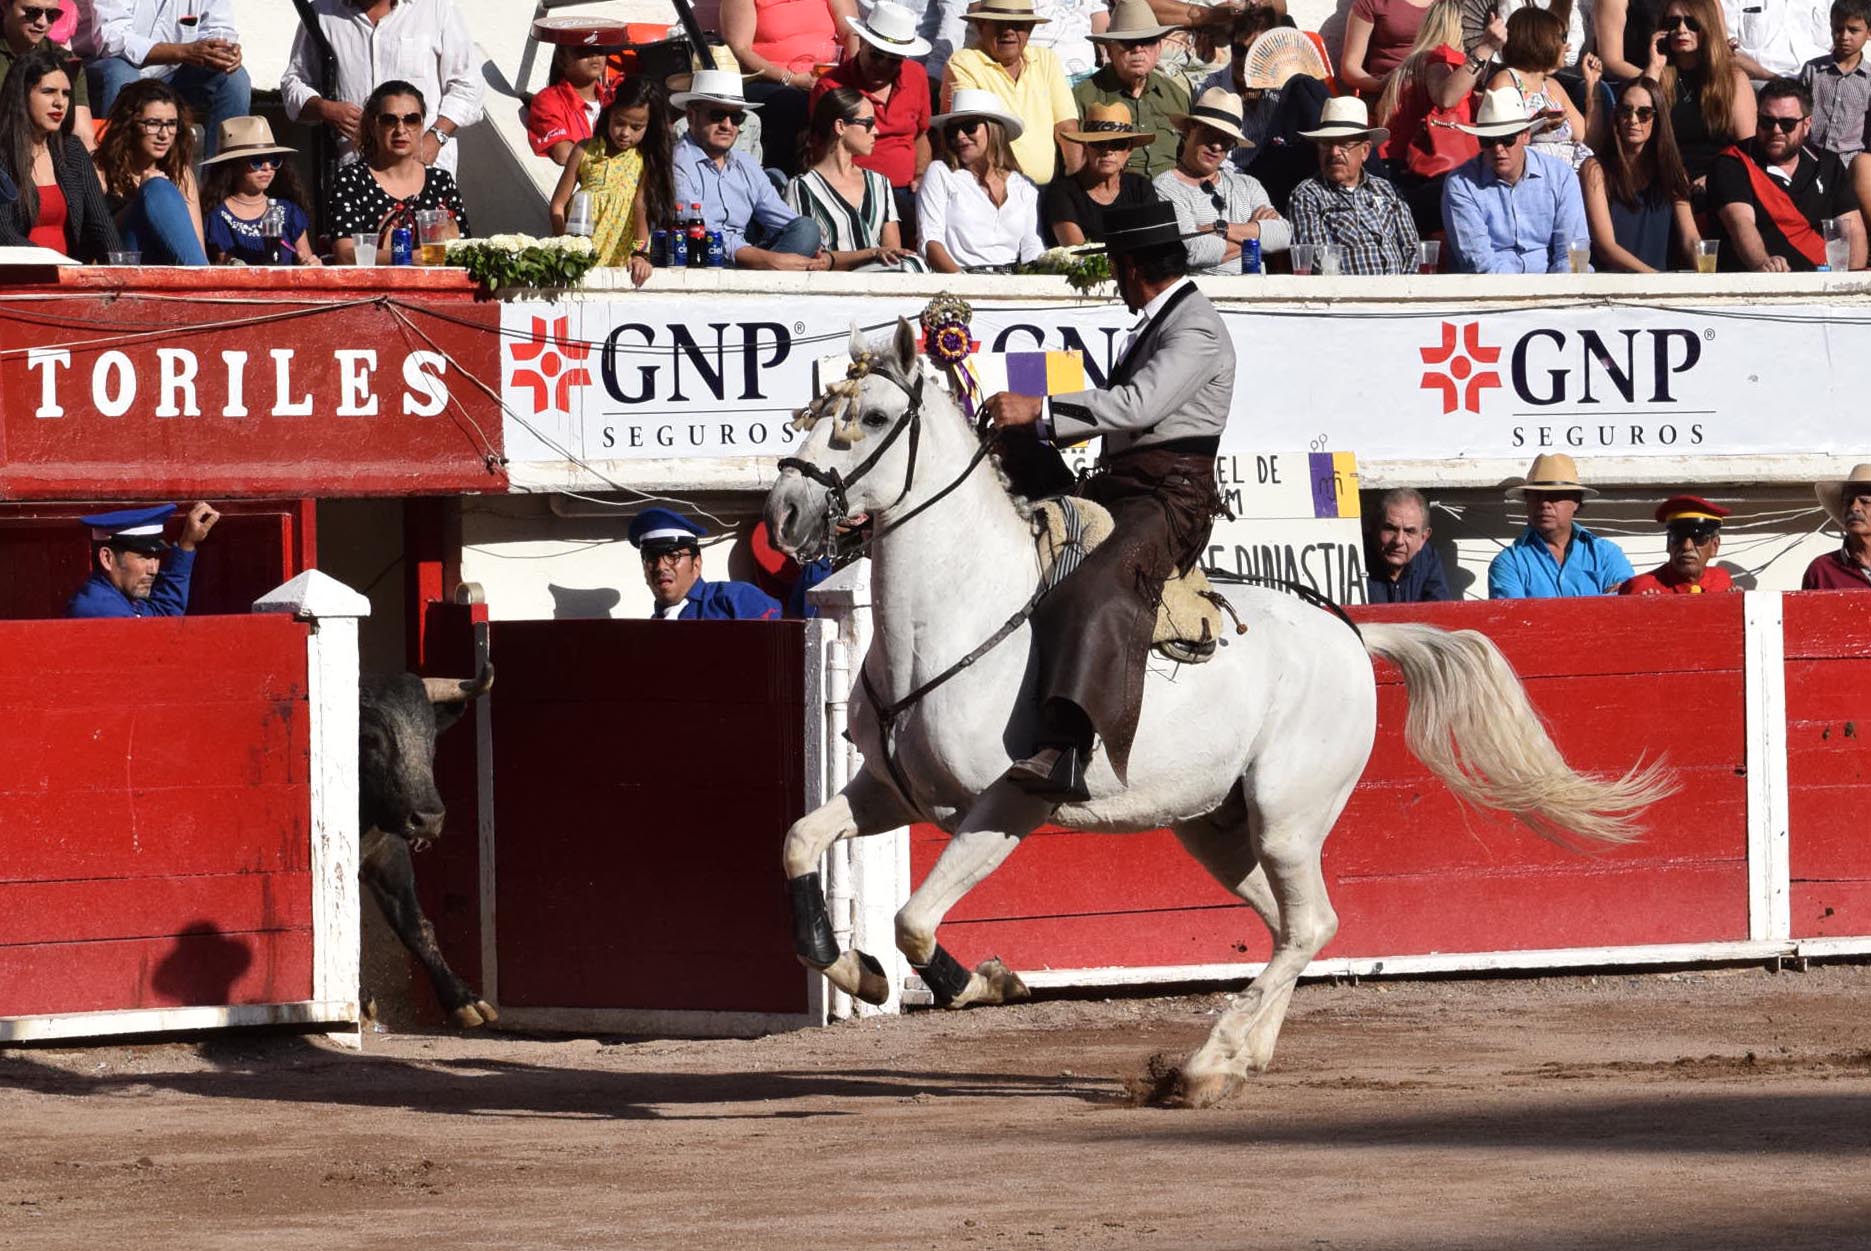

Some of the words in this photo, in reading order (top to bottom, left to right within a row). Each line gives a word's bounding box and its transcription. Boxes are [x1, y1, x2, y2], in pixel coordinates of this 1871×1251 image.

[27, 347, 449, 418] TORILES
[601, 322, 792, 404] GNP
[1511, 328, 1702, 406] GNP
[602, 422, 794, 448] SEGUROS
[1512, 423, 1704, 447] SEGUROS
[1256, 454, 1281, 484] DE
[1235, 542, 1369, 605] DINASTIA
